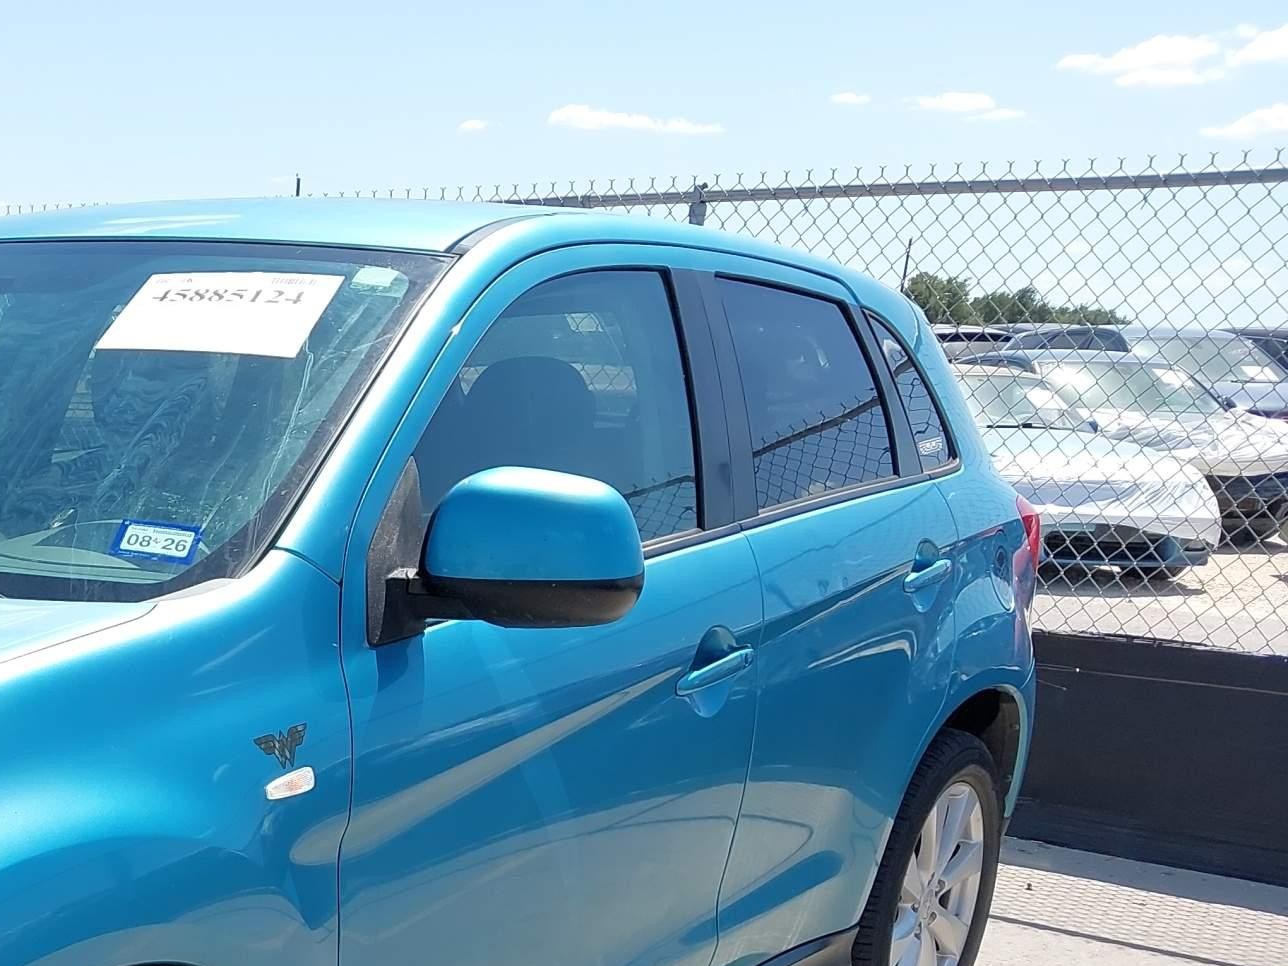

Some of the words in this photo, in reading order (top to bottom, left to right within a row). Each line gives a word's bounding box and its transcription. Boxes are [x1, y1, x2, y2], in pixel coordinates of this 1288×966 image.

[152, 289, 305, 305] 45885124
[127, 533, 152, 548] 08
[162, 537, 189, 552] 26
